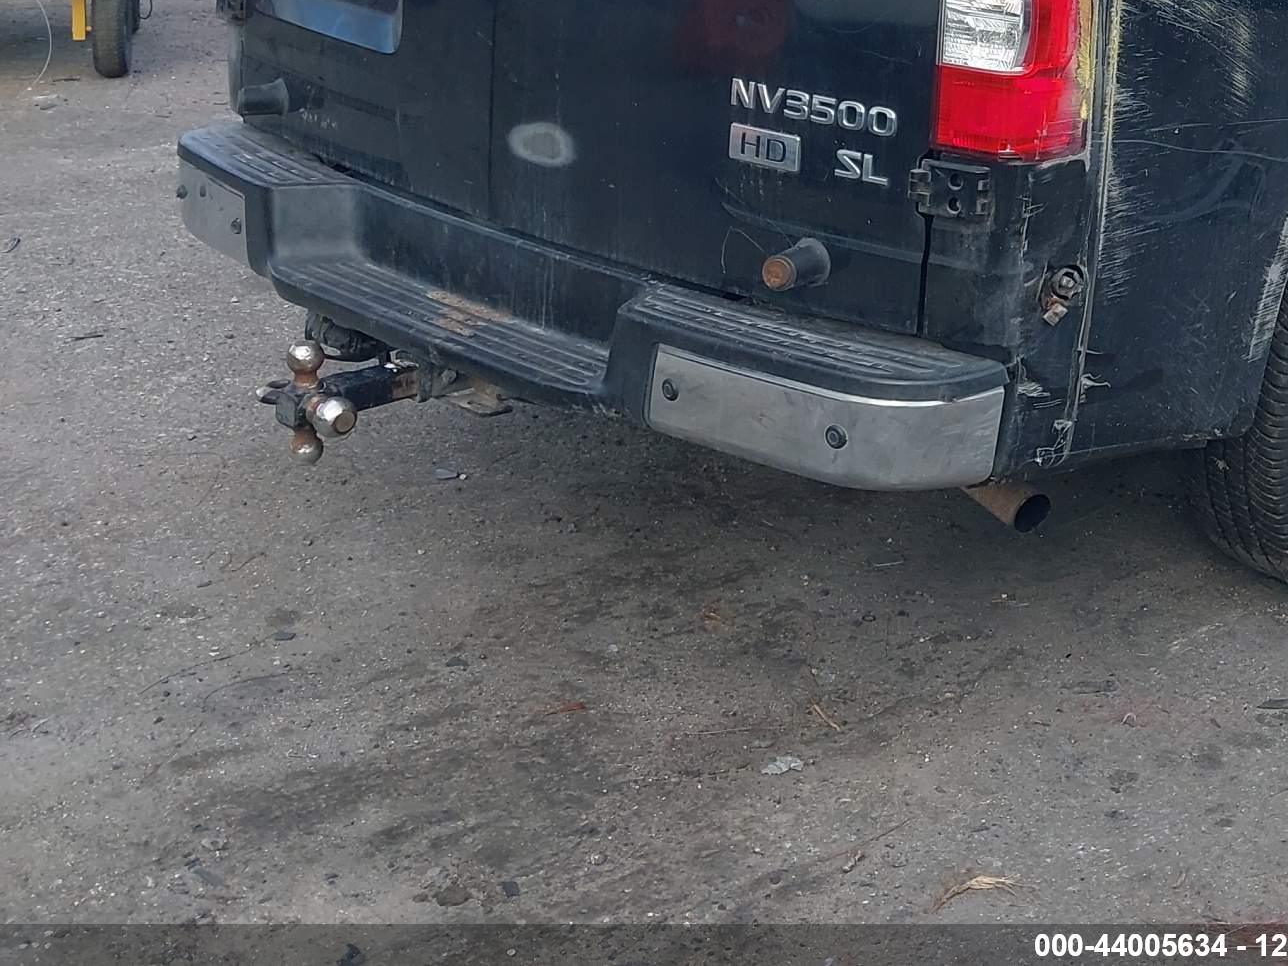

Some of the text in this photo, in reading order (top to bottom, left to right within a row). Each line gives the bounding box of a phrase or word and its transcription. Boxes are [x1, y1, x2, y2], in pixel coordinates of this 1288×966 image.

[730, 77, 898, 137] NV3500
[740, 132, 786, 162] HD
[834, 148, 888, 185] SL
